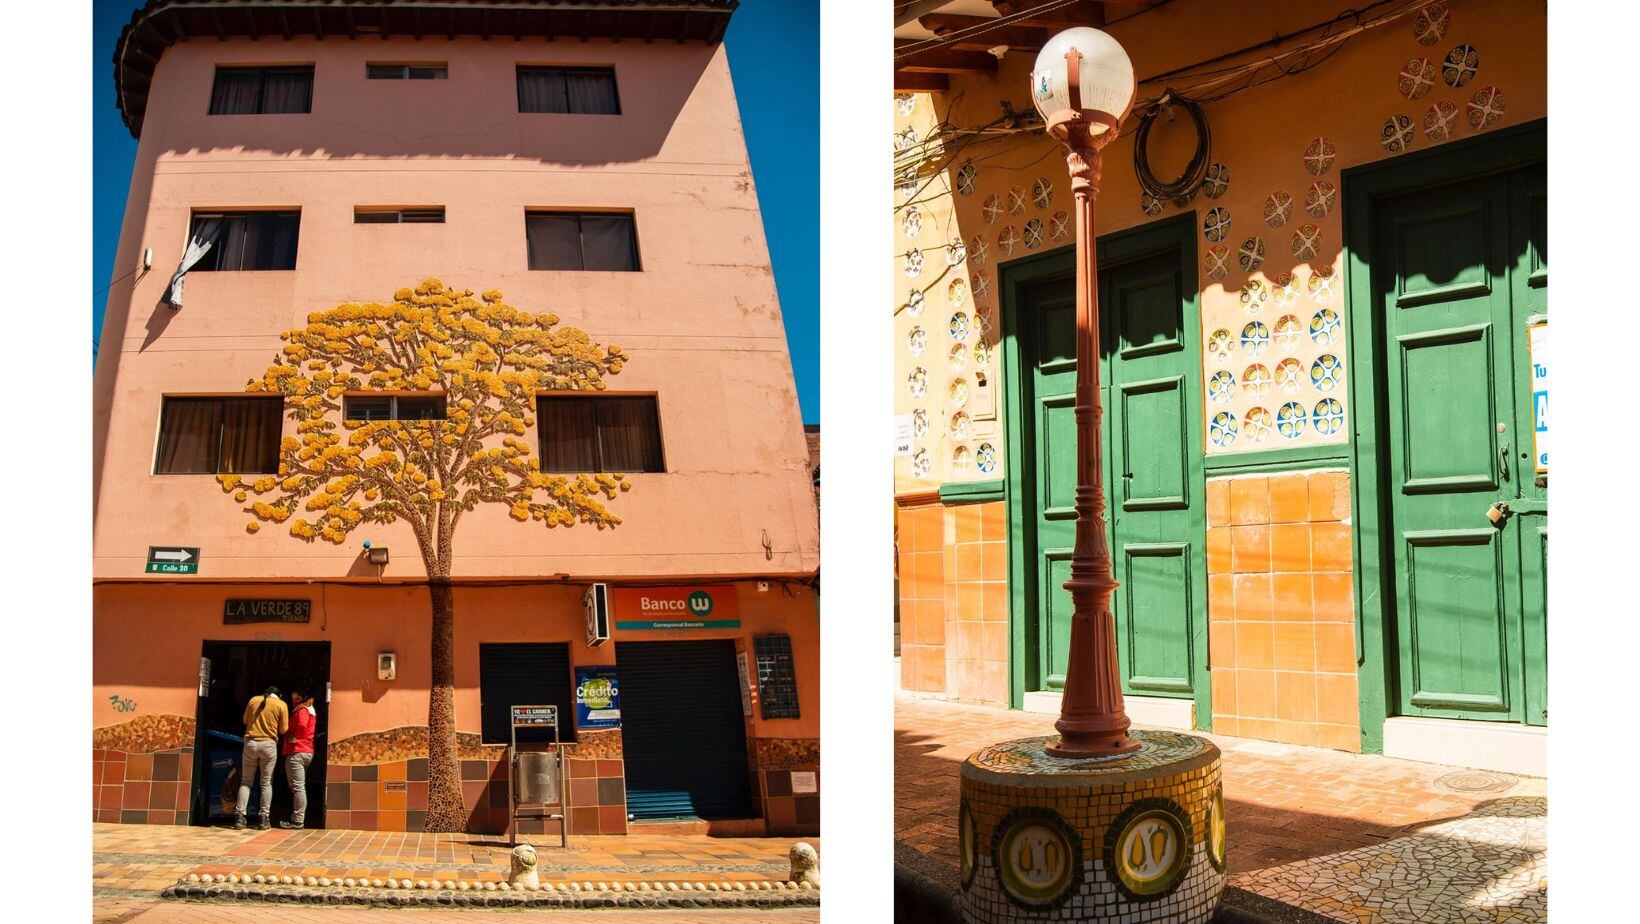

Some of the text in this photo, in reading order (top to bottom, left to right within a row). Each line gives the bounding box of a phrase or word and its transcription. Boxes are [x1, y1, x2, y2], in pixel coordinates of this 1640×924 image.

[1534, 364, 1547, 378] Tu
[226, 601, 309, 616] LA VERDE 89
[640, 597, 686, 610] Banco
[576, 686, 619, 697] Crédito
